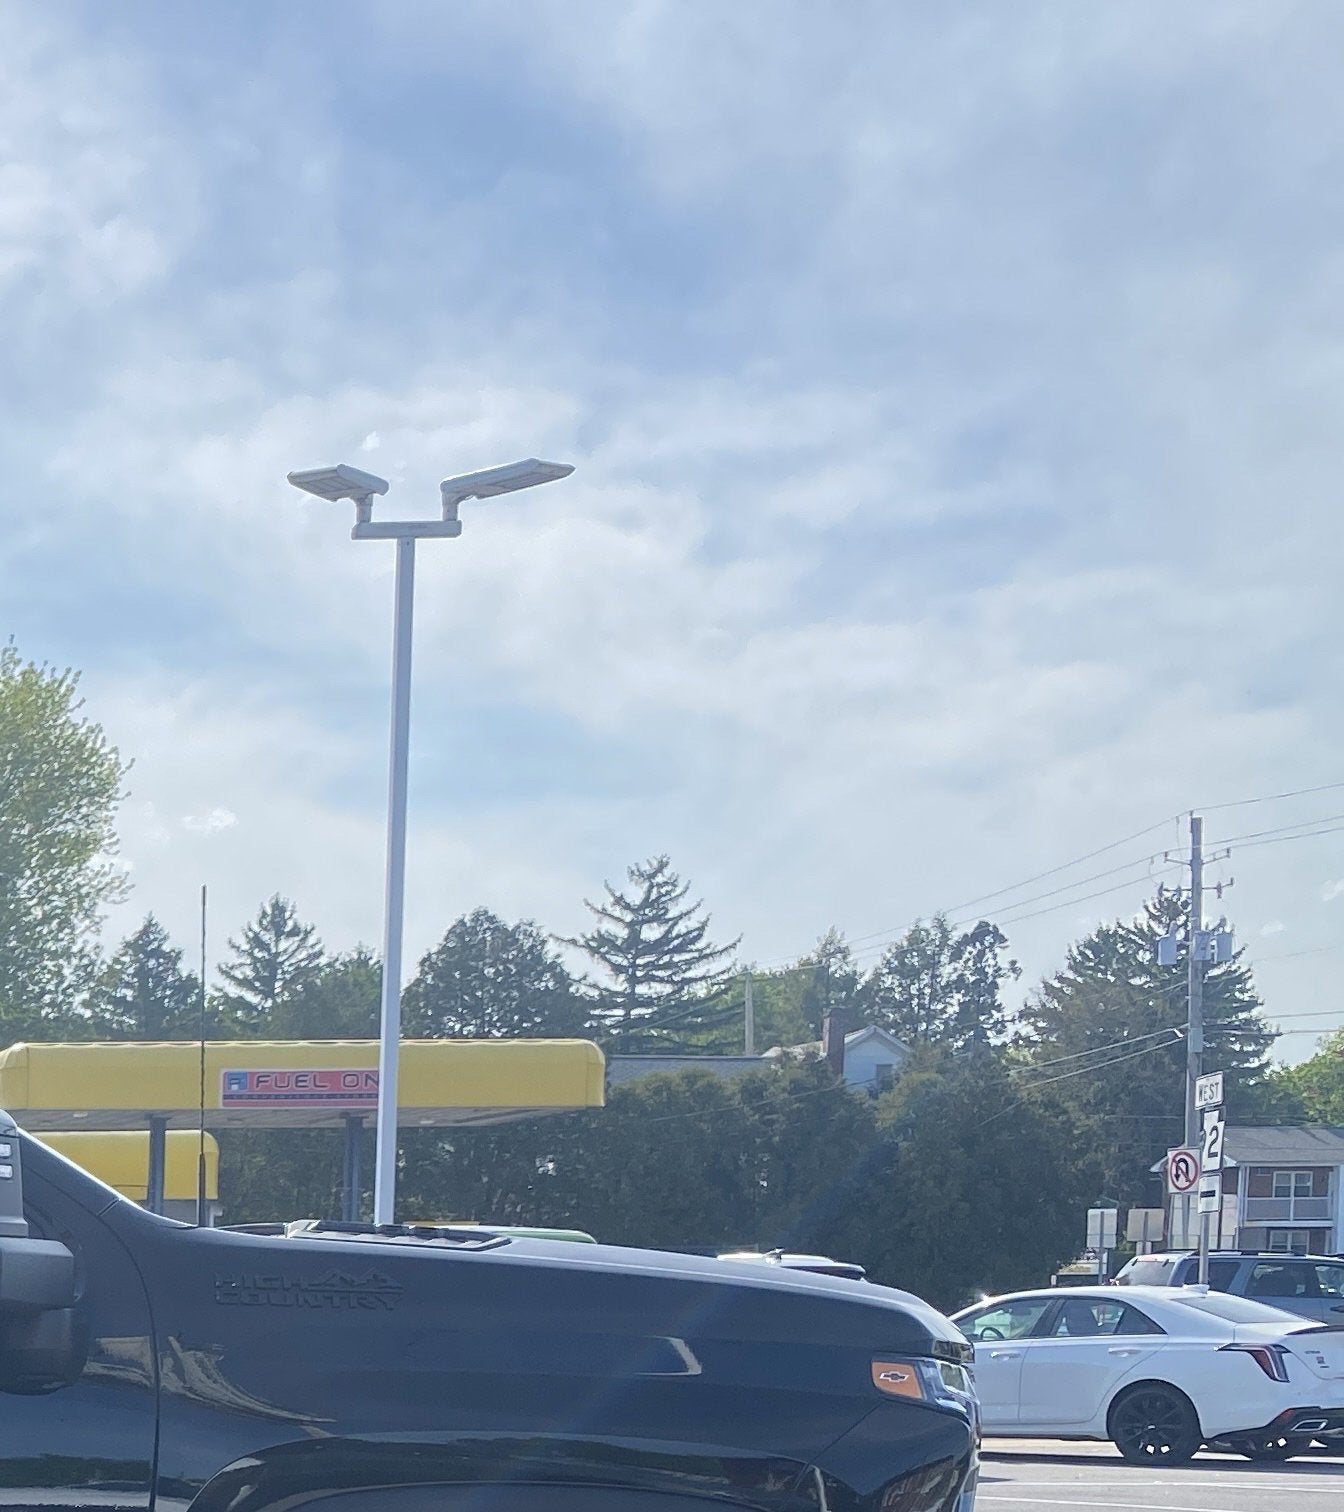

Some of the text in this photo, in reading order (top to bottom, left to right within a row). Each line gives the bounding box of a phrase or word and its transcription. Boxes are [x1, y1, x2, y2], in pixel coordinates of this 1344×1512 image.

[255, 1073, 329, 1090] FUEL
[1198, 1081, 1220, 1102] WEST
[214, 1291, 403, 1311] COUNTRY
